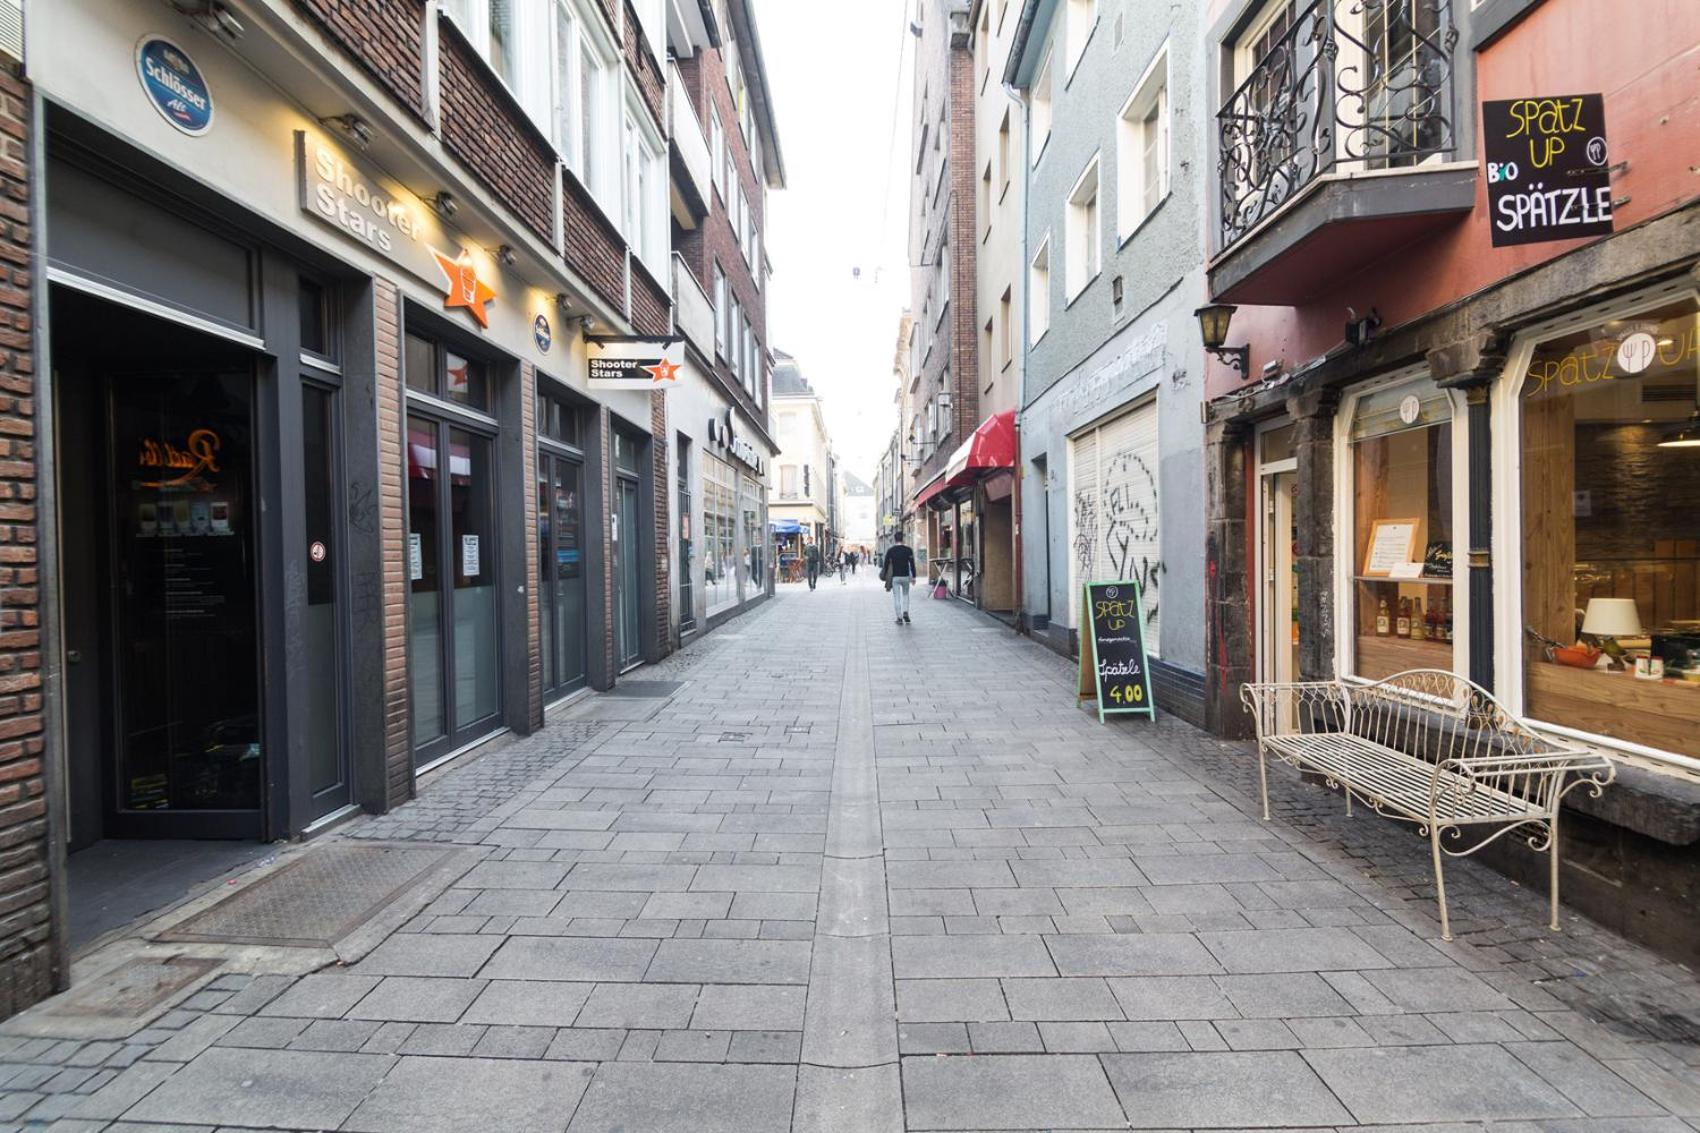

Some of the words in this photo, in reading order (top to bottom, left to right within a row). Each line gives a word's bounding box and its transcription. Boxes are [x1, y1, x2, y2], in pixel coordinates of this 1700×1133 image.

[145, 57, 206, 110] Schlösser
[1530, 136, 1565, 168] UP
[315, 146, 422, 240] Shooter
[1496, 181, 1613, 232] SPÄTZLE
[316, 182, 392, 251] Stars
[590, 360, 639, 369] Shooter
[590, 369, 624, 378] Stars
[1108, 619, 1126, 631] UP
[1109, 684, 1143, 704] 4.00
